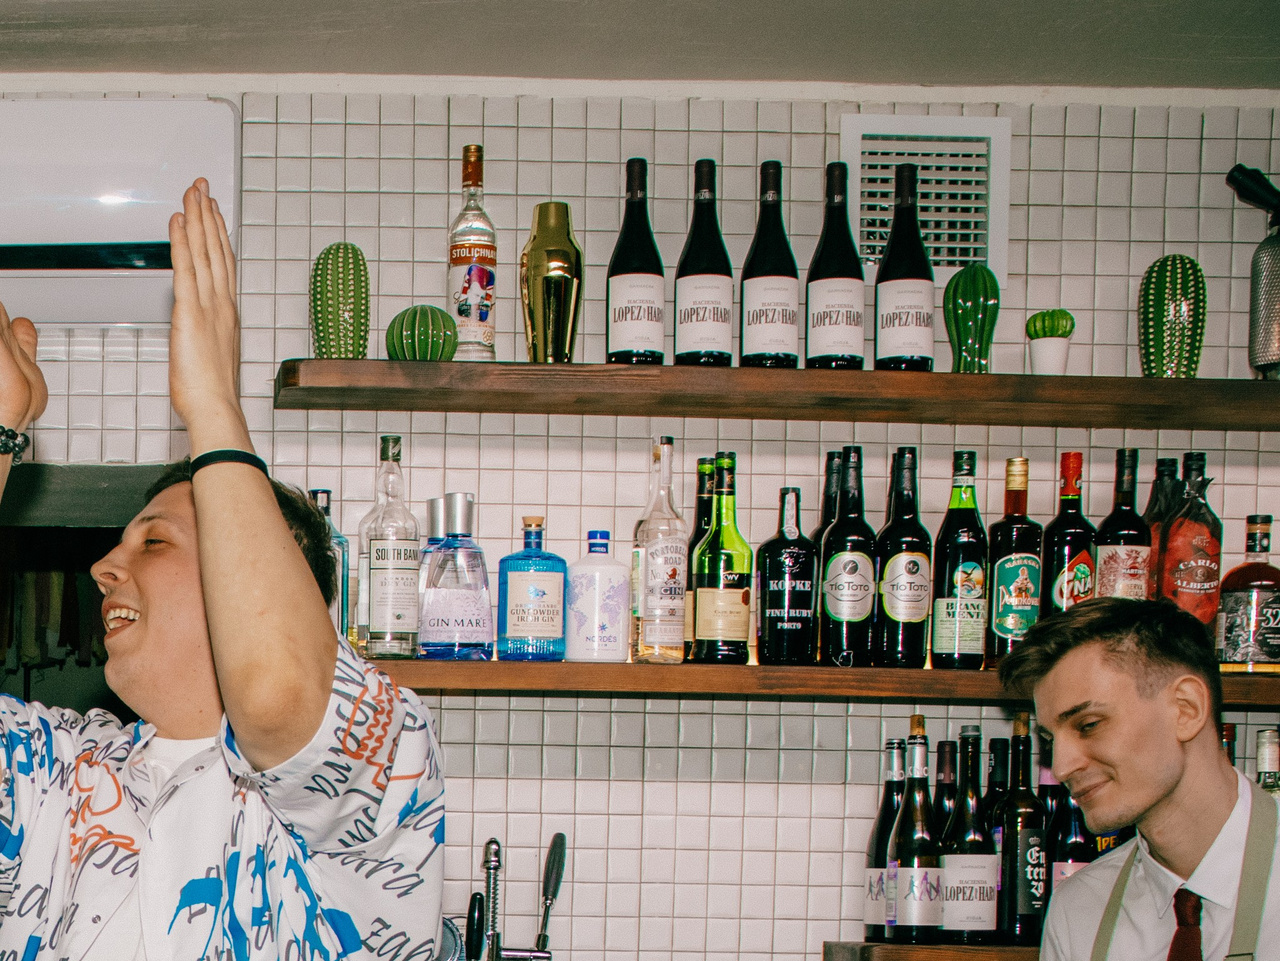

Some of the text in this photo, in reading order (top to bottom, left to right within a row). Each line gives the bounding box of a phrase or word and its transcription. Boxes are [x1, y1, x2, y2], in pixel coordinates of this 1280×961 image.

[613, 305, 642, 323] LOPEZ
[679, 307, 707, 325] LOPEZ
[747, 309, 776, 326] LOPEZ
[811, 311, 840, 328] LOPEZ
[880, 312, 910, 329] LOPEZ
[1178, 559, 1218, 570] CARLO
[769, 580, 812, 592] KOPKE
[510, 608, 560, 616] GUNOWDER
[429, 618, 488, 628] GIN MARE
[777, 622, 802, 630] PORTO
[944, 886, 974, 901] LOPEZ
